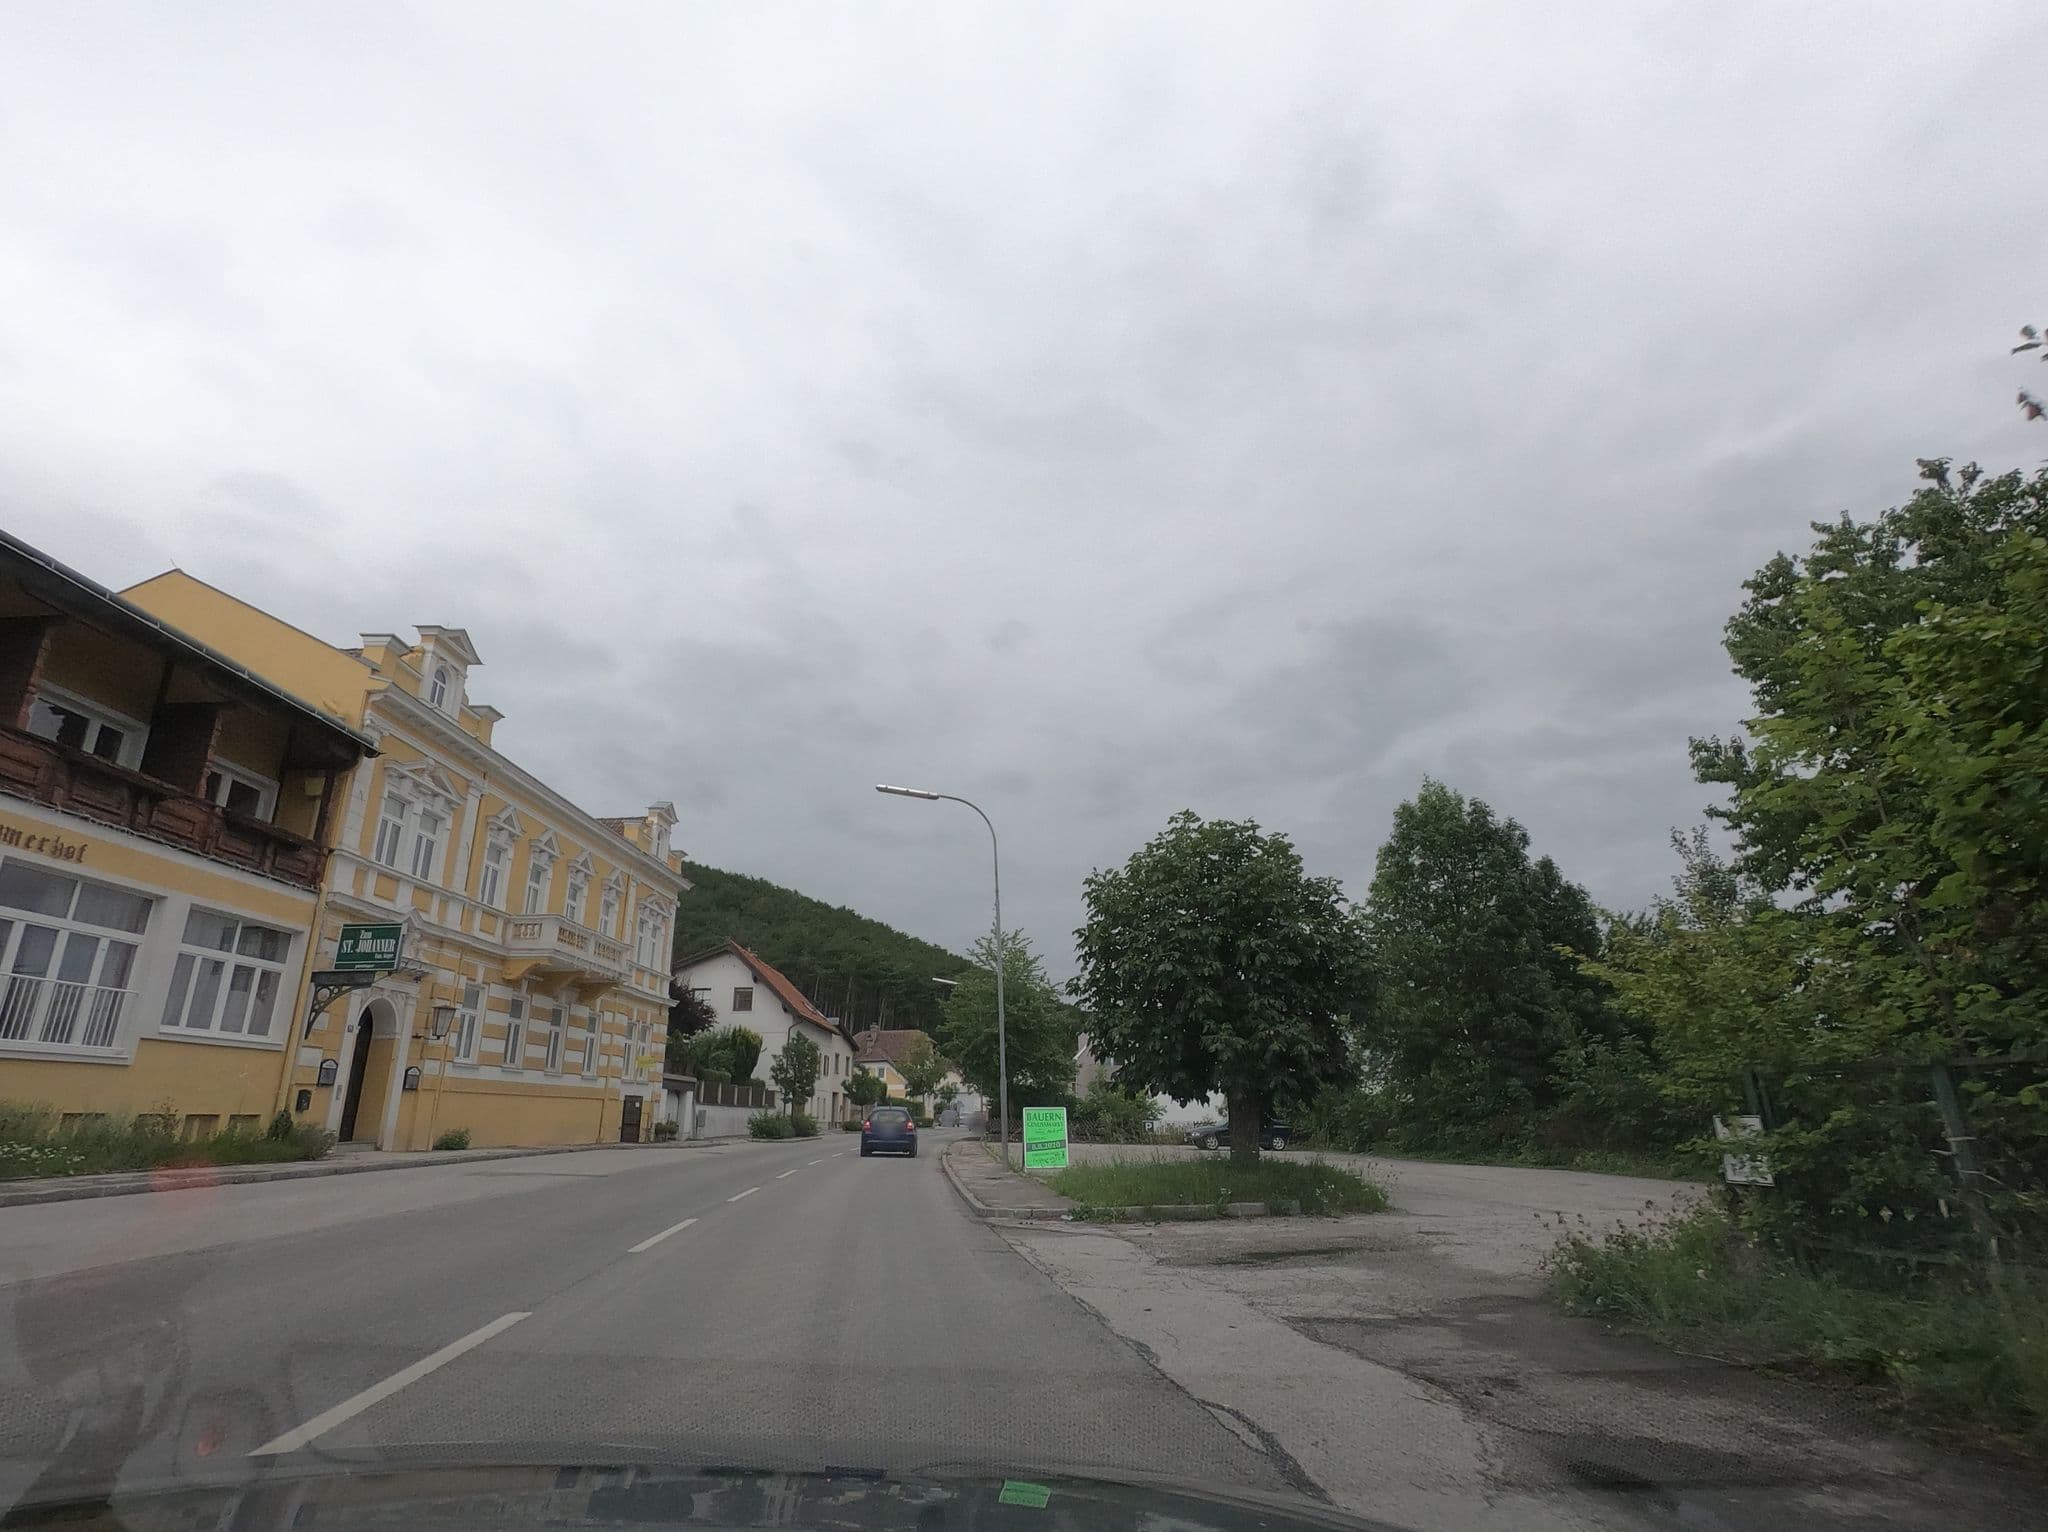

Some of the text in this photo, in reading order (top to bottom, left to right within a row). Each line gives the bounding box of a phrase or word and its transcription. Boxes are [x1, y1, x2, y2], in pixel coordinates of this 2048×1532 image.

[341, 939, 396, 953] ST. JOHANNER
[1145, 1122, 1153, 1131] P
